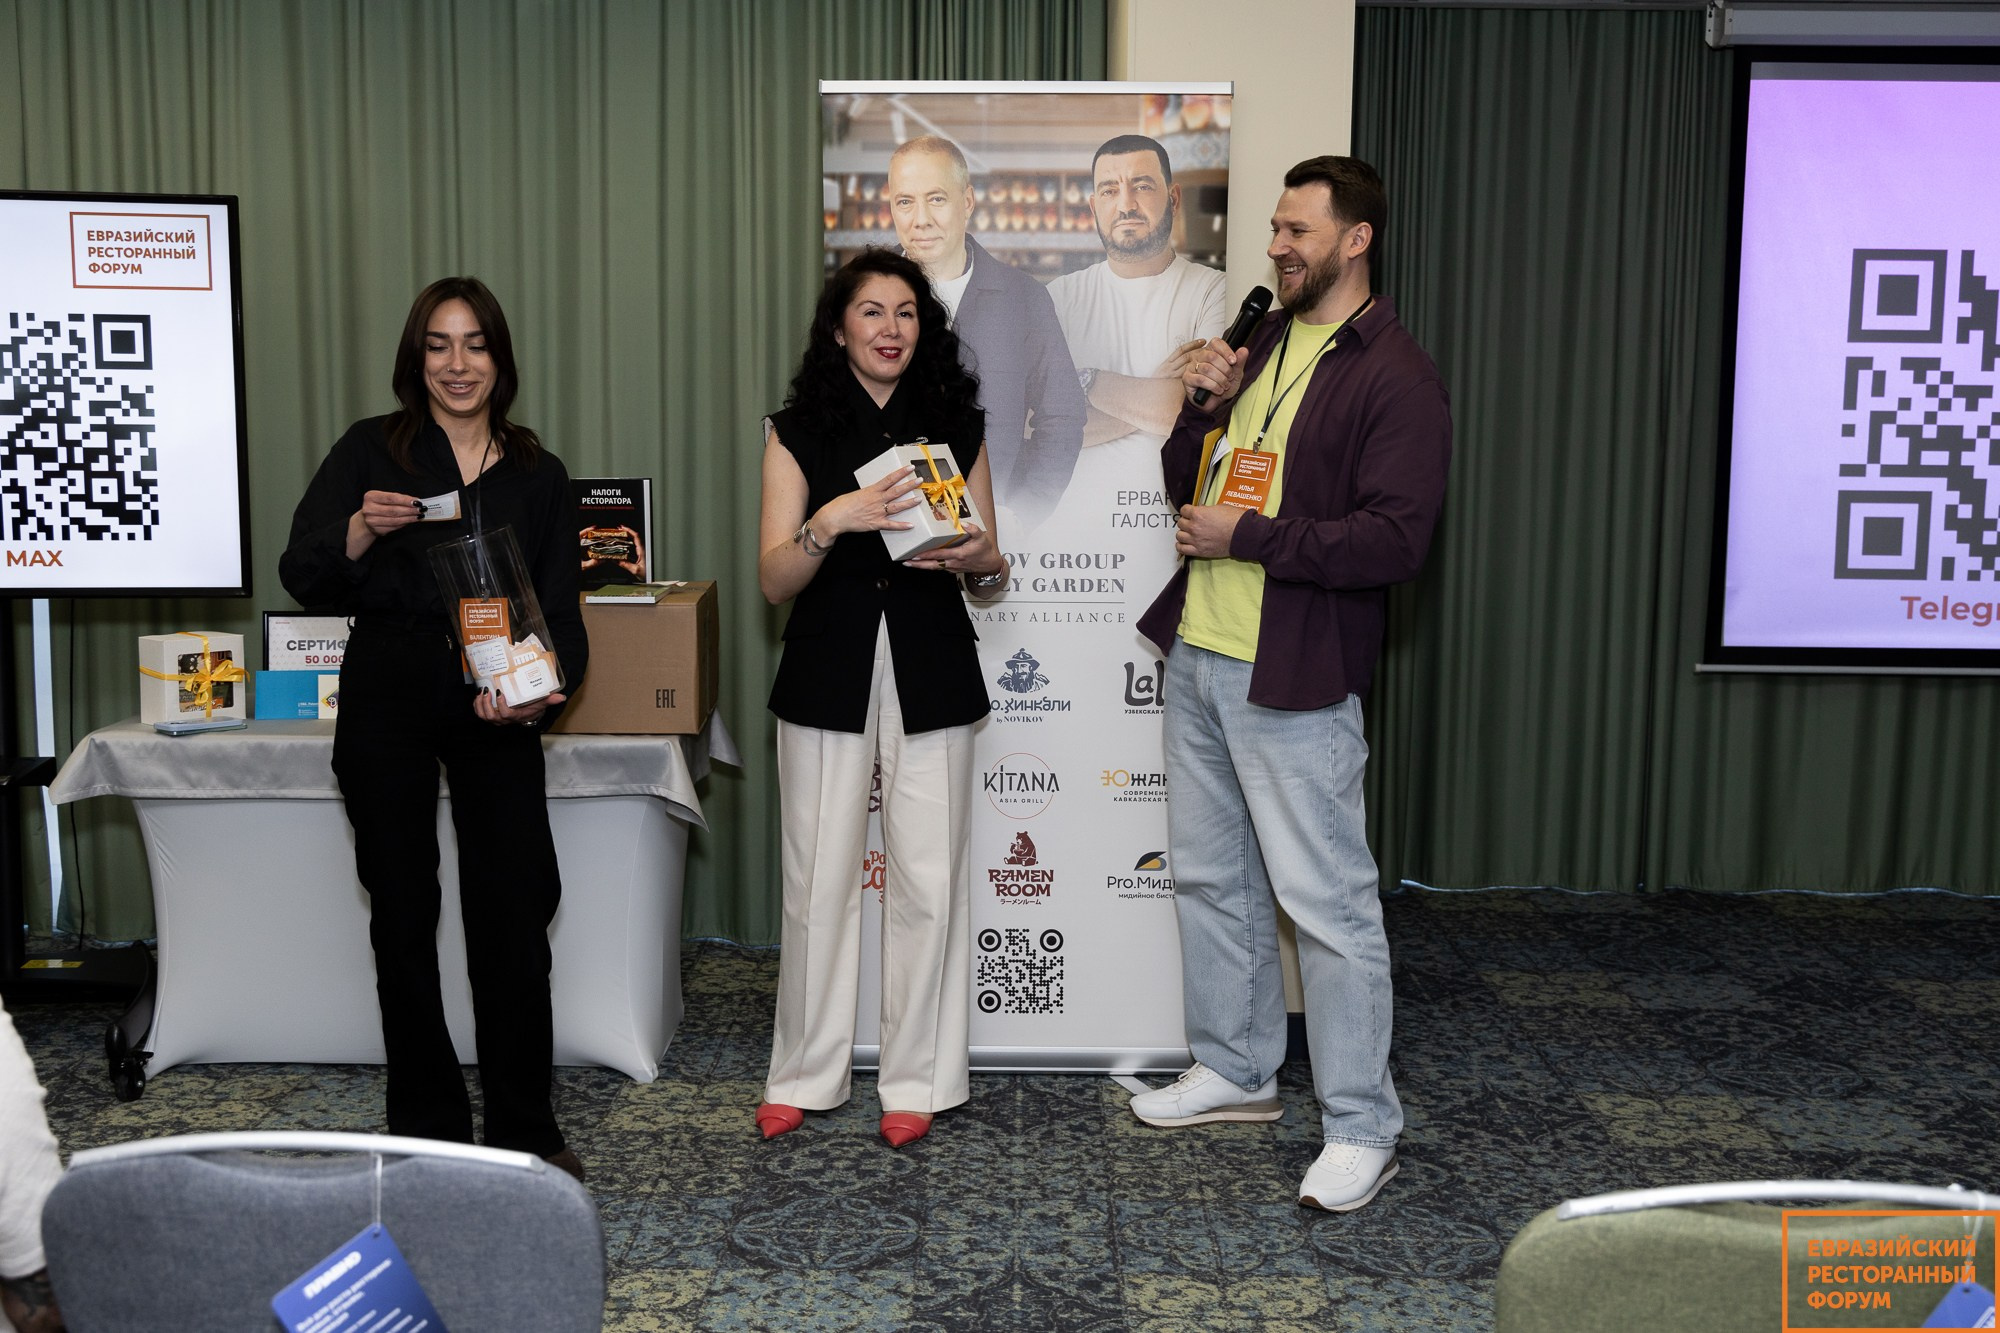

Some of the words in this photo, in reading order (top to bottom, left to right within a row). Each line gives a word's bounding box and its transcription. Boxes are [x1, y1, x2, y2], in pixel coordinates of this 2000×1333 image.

[86, 229, 197, 244] ЕВРАЗИЙСКИЙ
[87, 245, 197, 260] РЕСТОРАННЫЙ
[88, 262, 143, 275] ФОРУМ
[591, 488, 622, 496] НАЛОГИ
[1238, 484, 1255, 492] ИЛЬЯ
[581, 497, 632, 505] РЕСТОРАТОРА
[1225, 490, 1263, 502] ЛЕВАШЕНКО
[6, 550, 64, 567] MAX
[1039, 552, 1126, 570] GROUP
[1032, 577, 1126, 593] GARDEN
[1029, 612, 1126, 623] ALLIANCE
[1900, 595, 2000, 627] Teleg
[305, 655, 320, 664] 50
[987, 868, 1054, 883] RAMEN
[994, 883, 1051, 897] ROOM
[999, 898, 1042, 906] ラーメンルーム
